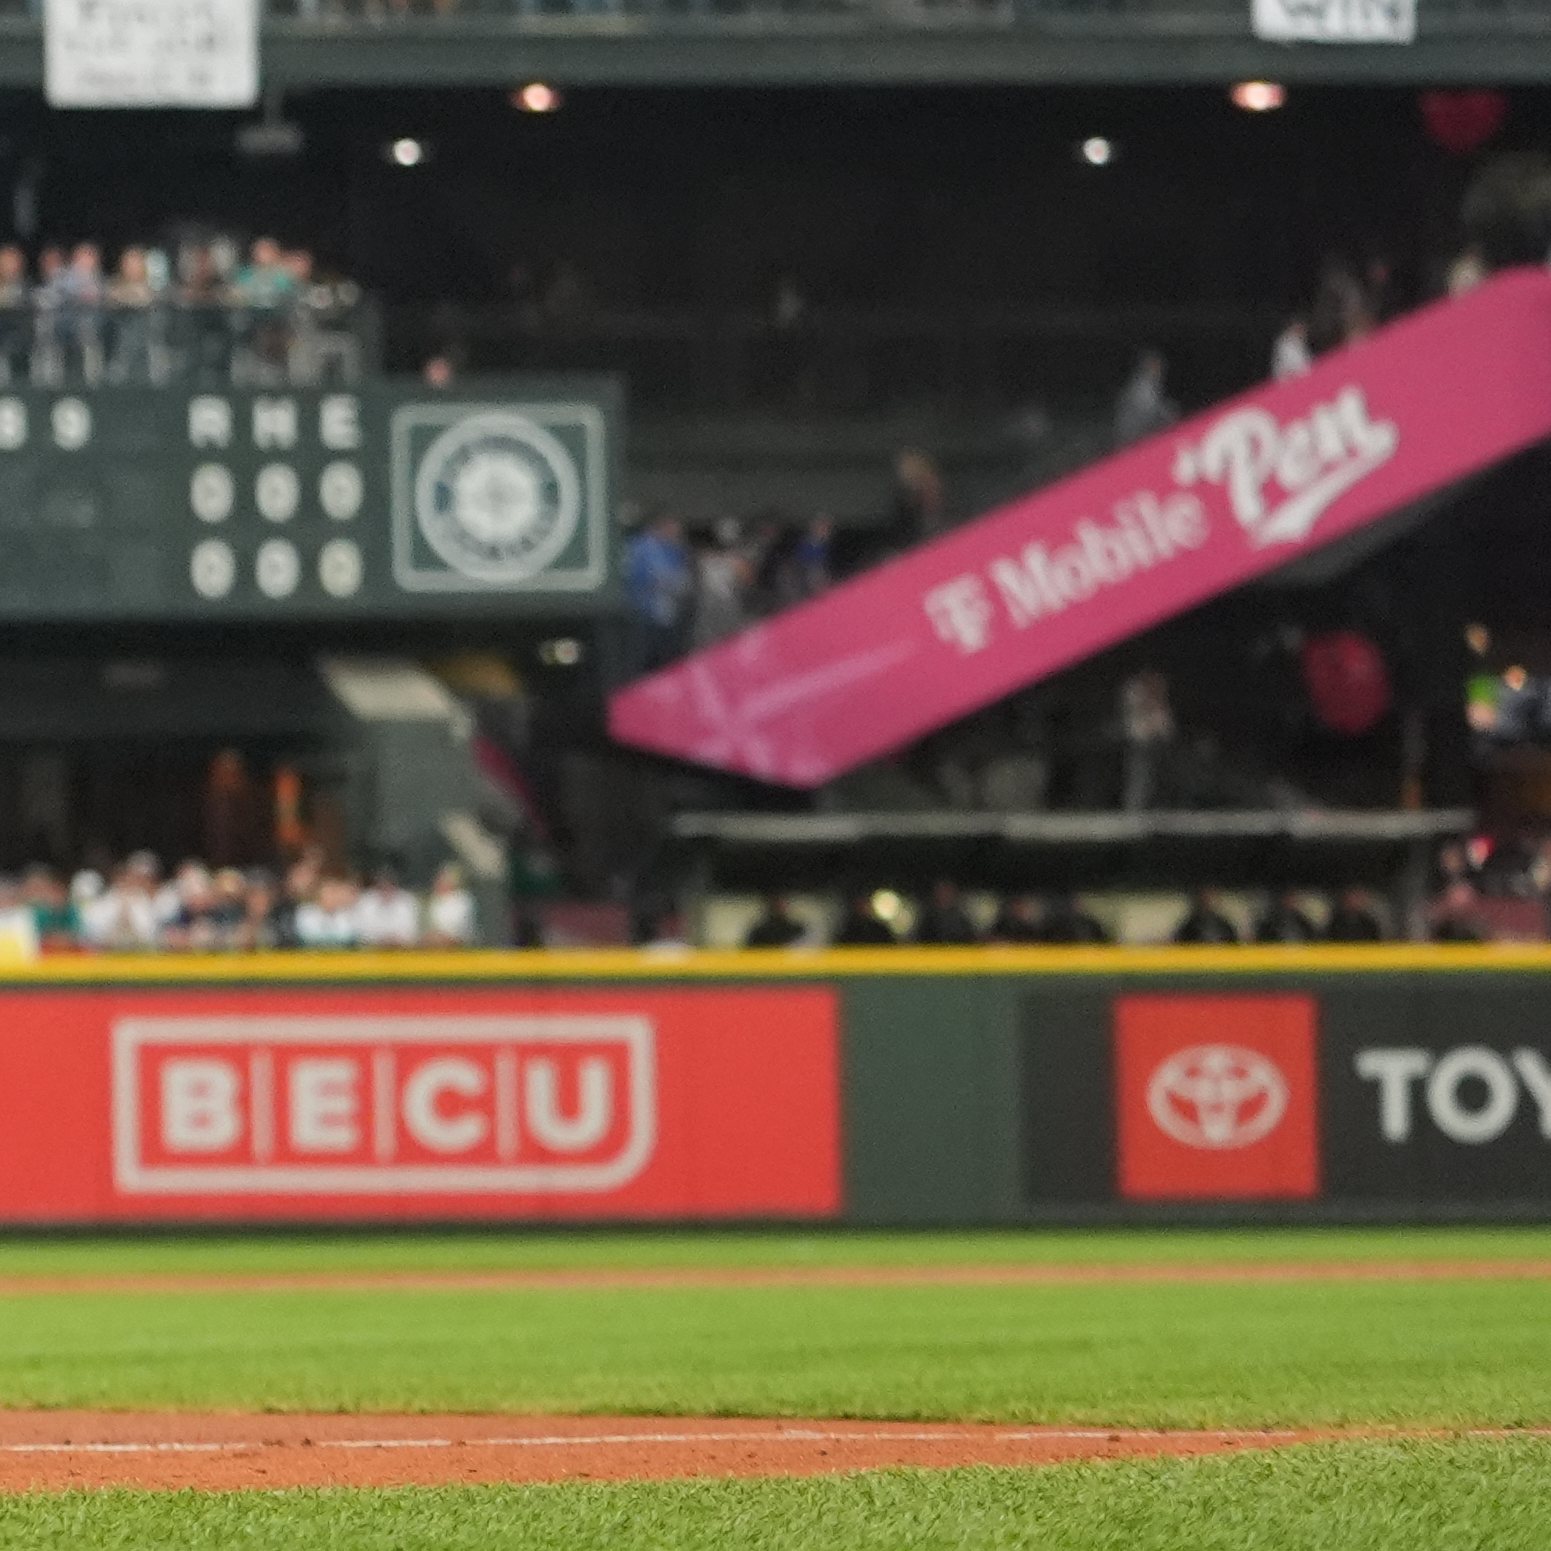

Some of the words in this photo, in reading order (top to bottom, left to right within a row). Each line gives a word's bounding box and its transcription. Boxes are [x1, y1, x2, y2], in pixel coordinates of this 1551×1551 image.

[51, 399, 90, 450] 9
[188, 396, 232, 448] R
[253, 396, 297, 448] H
[319, 396, 362, 448] E
[190, 462, 234, 522] 0
[255, 462, 299, 522] 0
[319, 462, 363, 522] 0
[190, 538, 234, 598] 0
[255, 538, 299, 598] 0
[319, 538, 363, 598] 0
[989, 491, 1210, 630] Mobile
[160, 1054, 613, 1155] BECU
